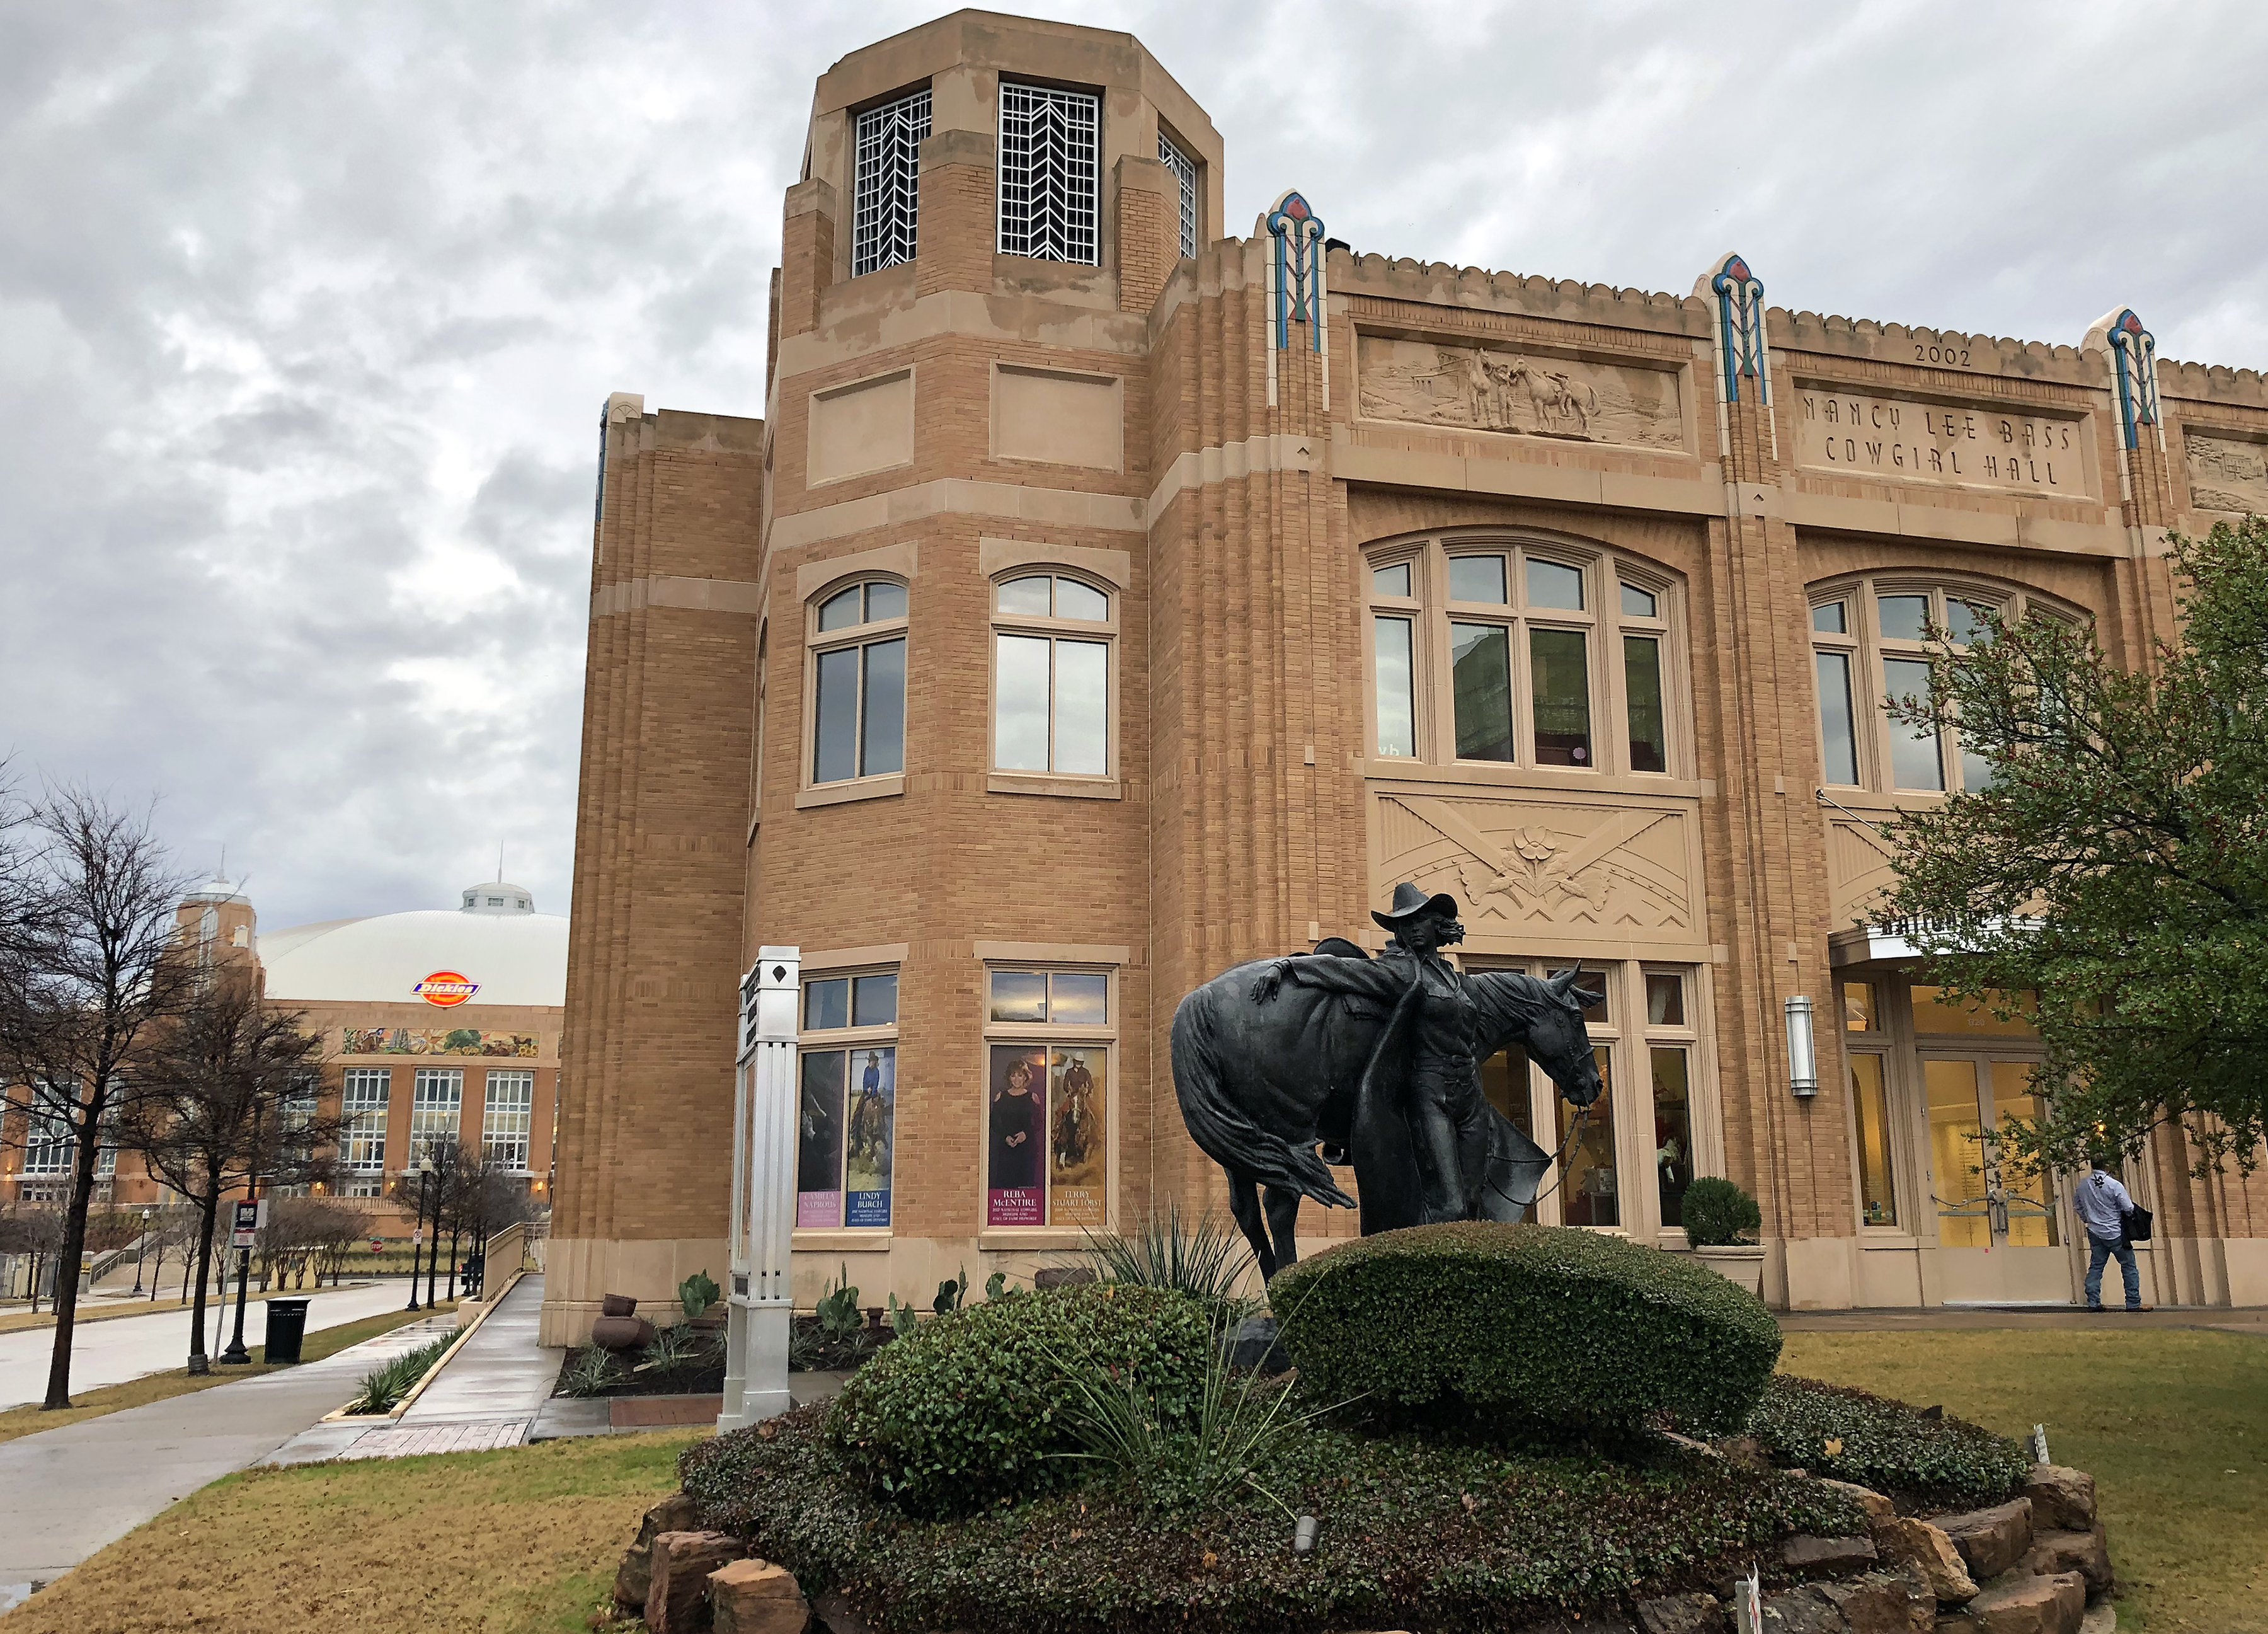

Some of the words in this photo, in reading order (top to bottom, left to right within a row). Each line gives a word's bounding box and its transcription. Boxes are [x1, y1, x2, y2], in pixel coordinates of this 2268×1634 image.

[1915, 344, 1971, 367] 2002
[1804, 396, 1900, 430] NANCY
[1925, 412, 1976, 440] LEE
[2000, 420, 2069, 450] BASS
[1826, 437, 1962, 475] COWGIRL
[1983, 455, 2057, 485] HALL
[417, 984, 474, 993] Dickies
[859, 1192, 881, 1200] LINDY
[1065, 1190, 1089, 1199] TERRY
[992, 1199, 1037, 1207] McENTIRE
